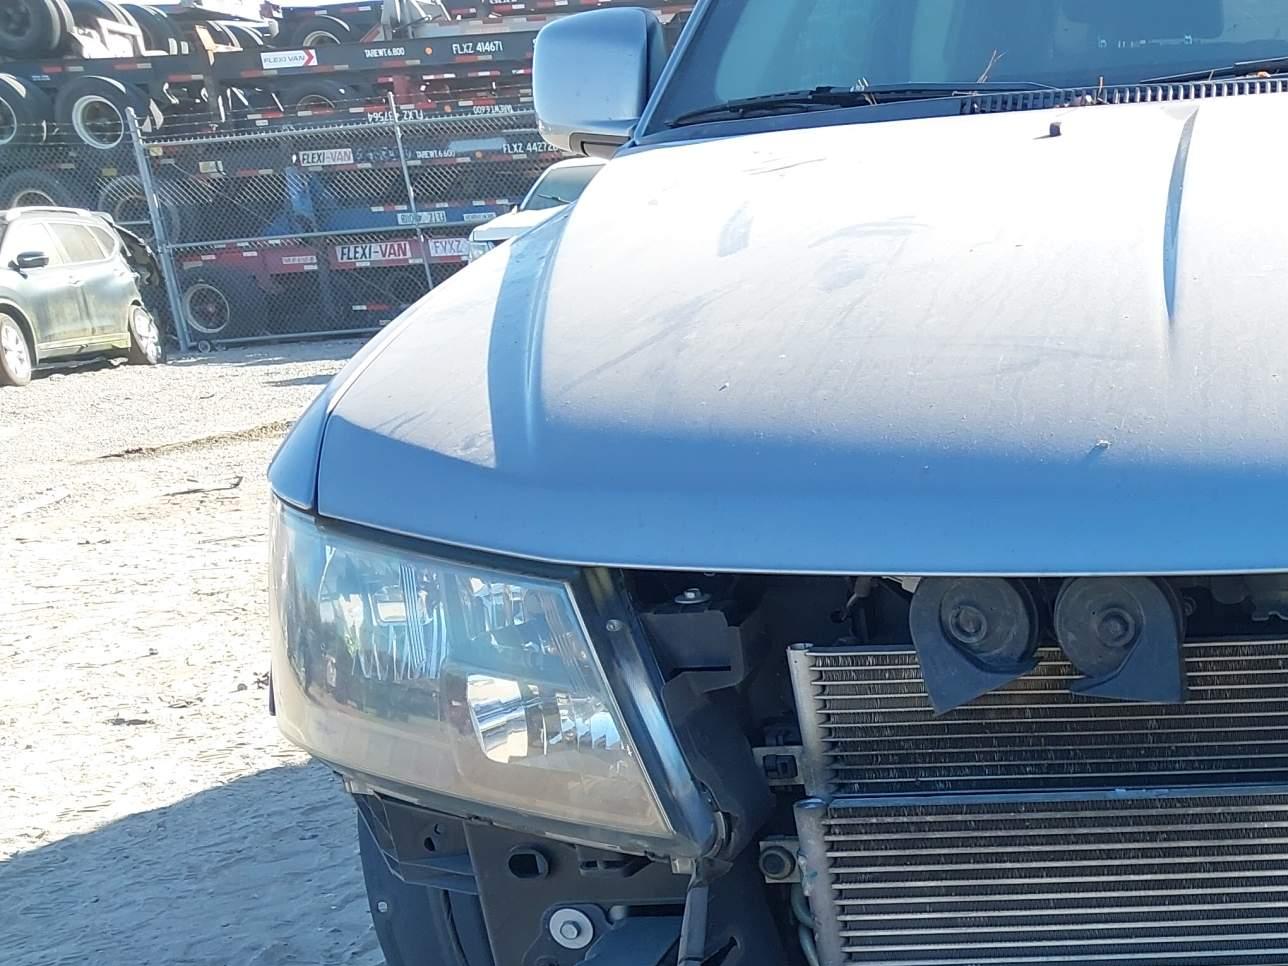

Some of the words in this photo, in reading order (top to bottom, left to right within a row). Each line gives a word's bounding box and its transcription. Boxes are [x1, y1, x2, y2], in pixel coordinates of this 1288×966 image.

[452, 42, 475, 54] FLXZ
[476, 40, 503, 52] 414671
[502, 143, 524, 154] FLXZ
[302, 150, 352, 164] FLEXI-VAN
[340, 242, 408, 261] FLEXI-VAN
